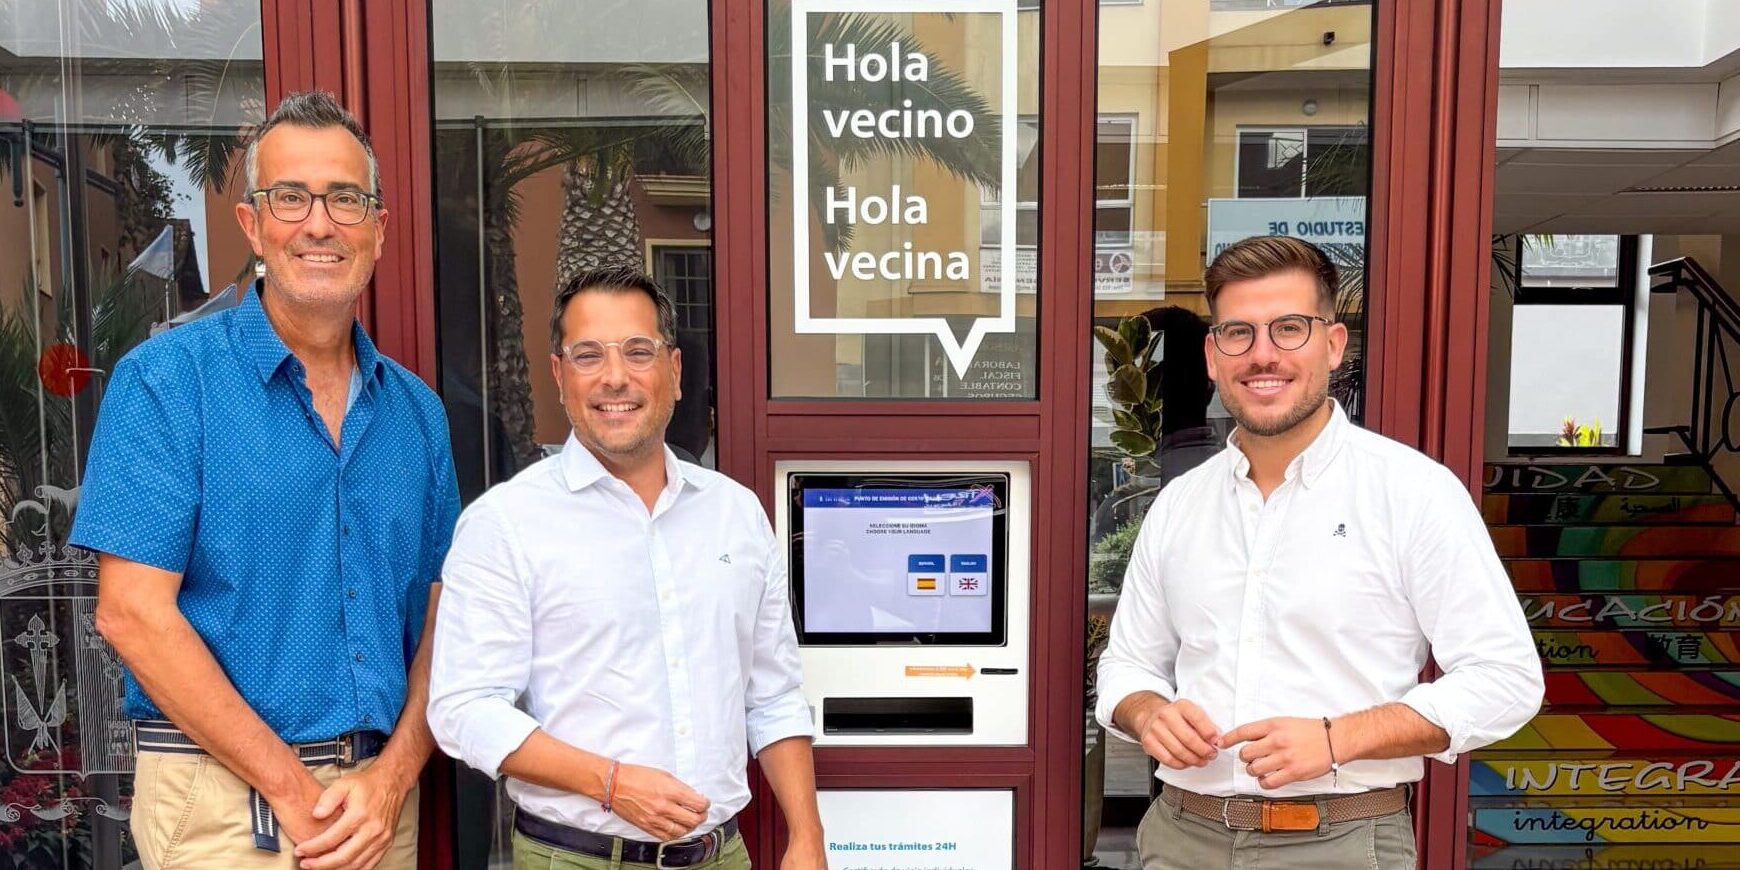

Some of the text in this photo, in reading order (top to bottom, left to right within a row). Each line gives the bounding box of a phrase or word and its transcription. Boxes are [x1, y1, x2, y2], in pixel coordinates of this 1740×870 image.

[824, 41, 929, 82] Hola
[822, 99, 974, 139] vecino
[825, 185, 928, 225] Hola
[823, 242, 970, 280] vecina
[1513, 810, 1708, 841] integration
[829, 842, 957, 851] Realiza tus trámites 24H
